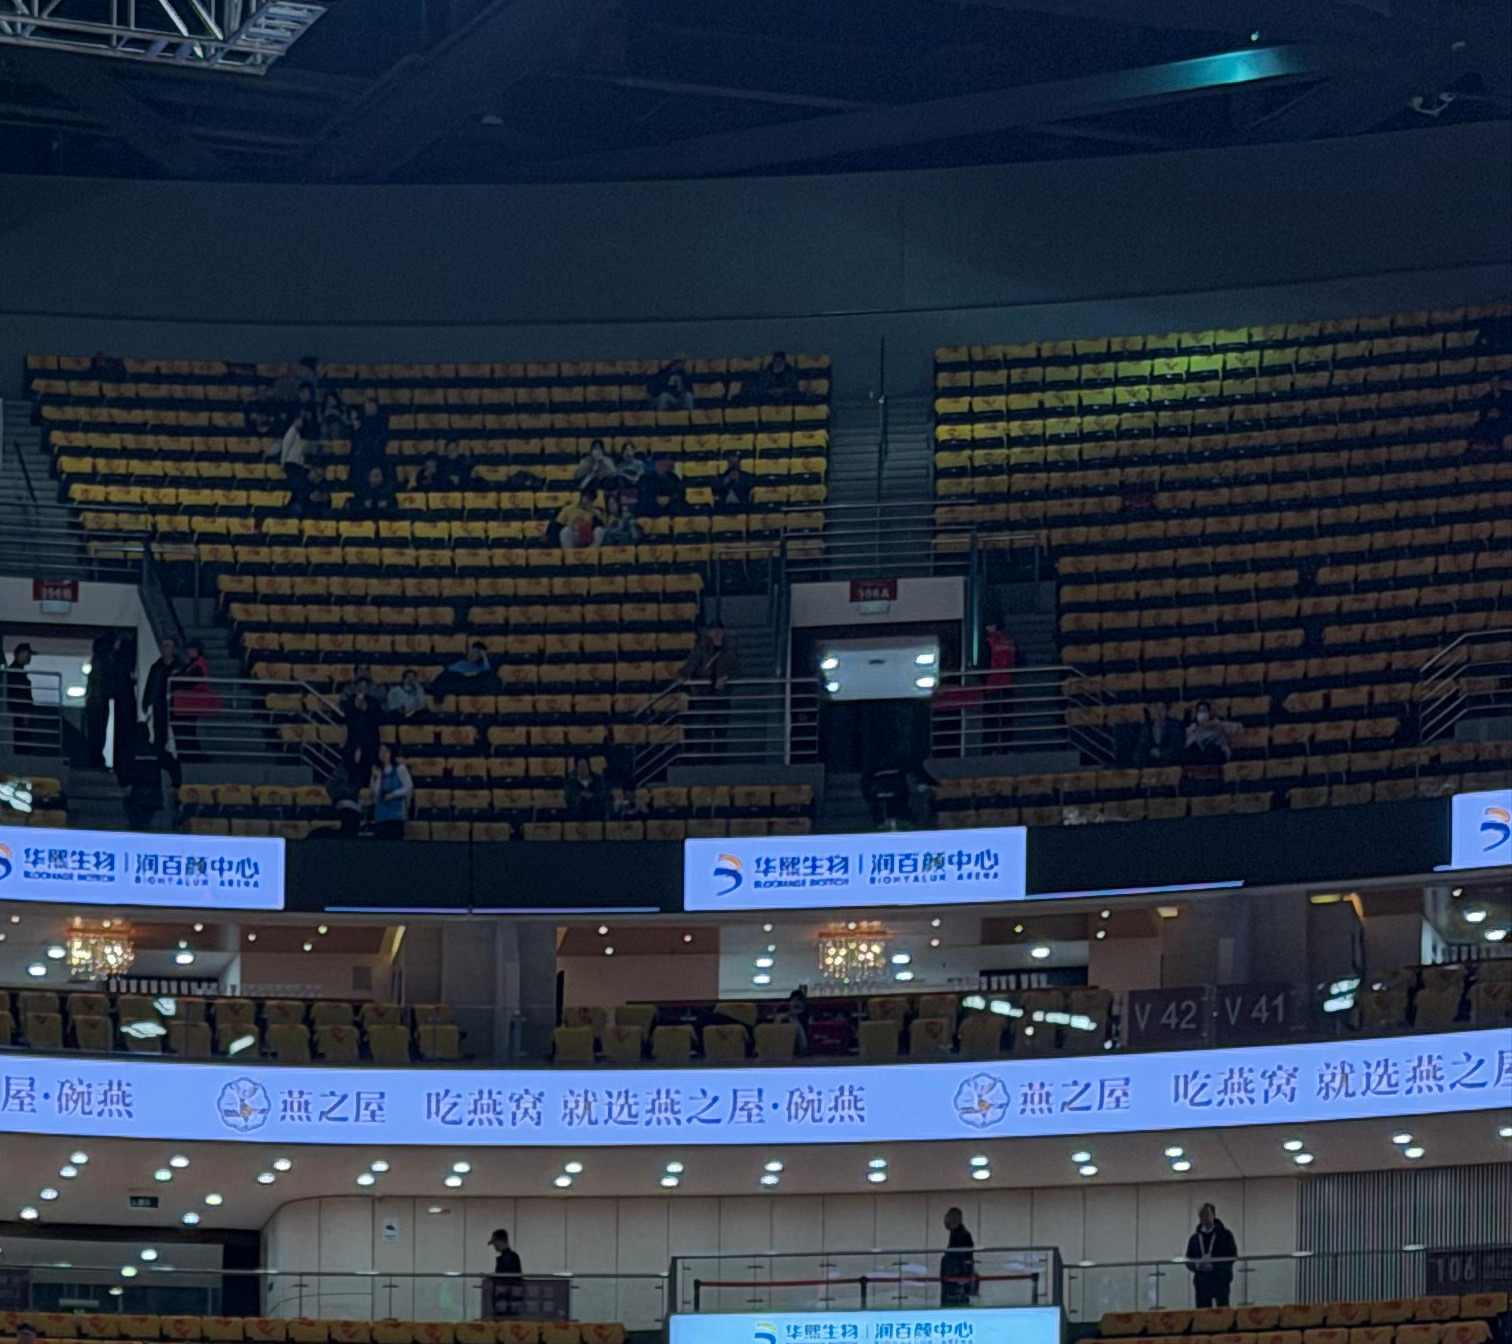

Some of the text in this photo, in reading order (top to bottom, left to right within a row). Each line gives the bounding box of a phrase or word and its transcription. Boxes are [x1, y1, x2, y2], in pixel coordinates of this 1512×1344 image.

[1018, 1076, 1130, 1116] 燕之屋
[1172, 1064, 1299, 1108] 吃燕窝
[279, 1089, 386, 1124] 燕之屋
[426, 1088, 544, 1128] 吃燕窝
